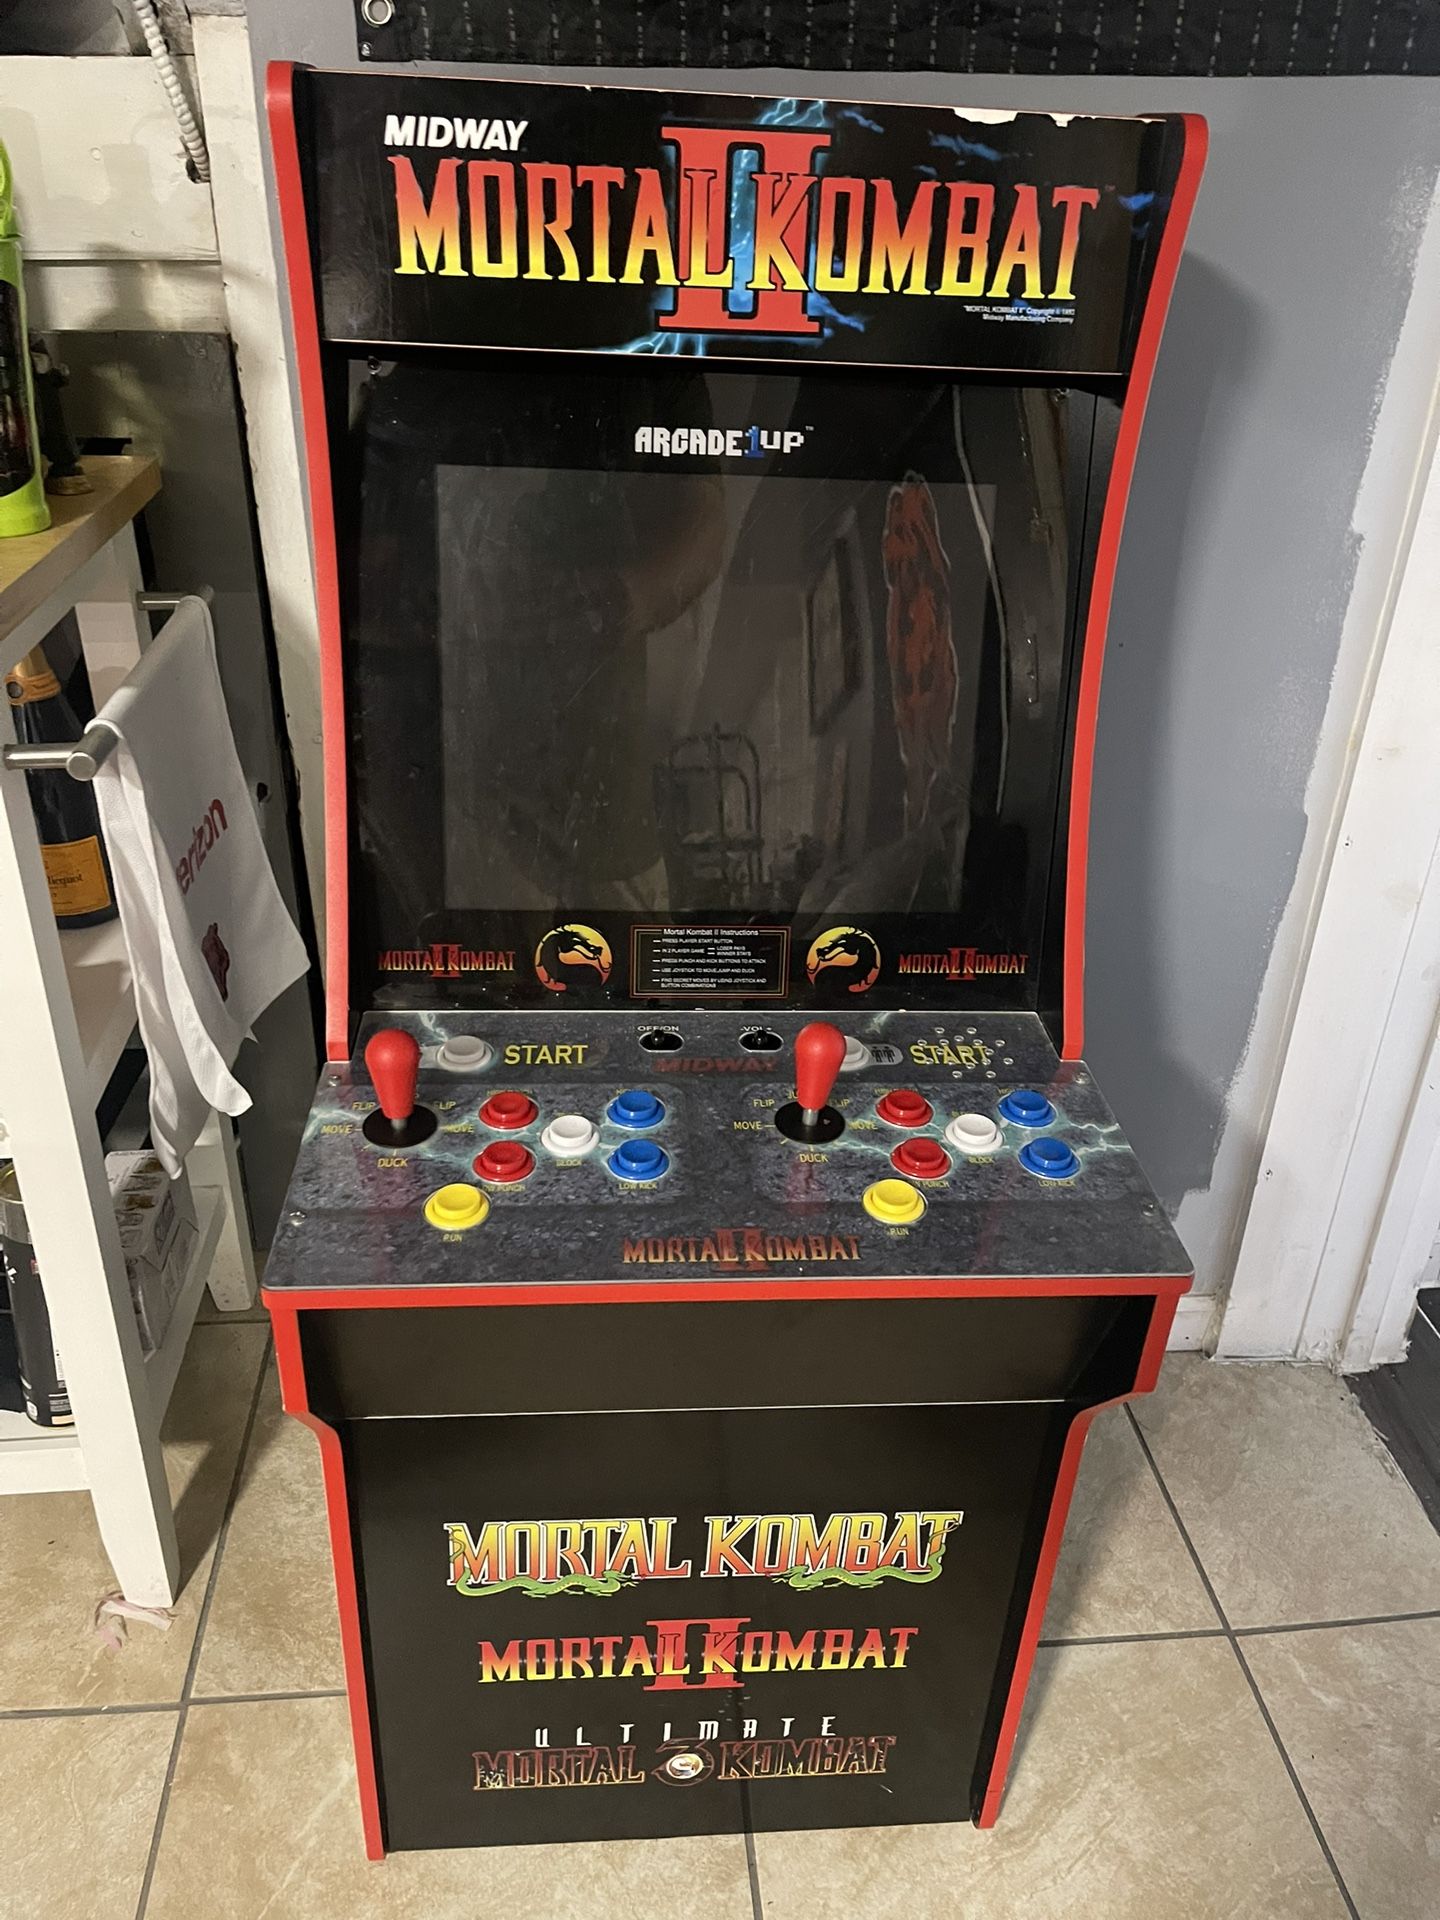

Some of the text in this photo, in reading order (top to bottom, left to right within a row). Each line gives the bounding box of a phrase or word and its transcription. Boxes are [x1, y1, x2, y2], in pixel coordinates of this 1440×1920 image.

[383, 115, 528, 151] MIDWAY
[388, 155, 1100, 299] MORTAL KOMBAT
[176, 798, 228, 896] erizon
[663, 928, 685, 936] Mortal
[686, 928, 713, 936] Kombat
[378, 950, 516, 971] MORTAL KOMBAT
[898, 953, 1029, 974] MORTAL KOMBAT
[504, 1044, 588, 1066] START
[909, 1044, 988, 1066] START
[653, 1056, 779, 1073] MIDWAY
[352, 1101, 376, 1111] FLIP
[753, 1100, 775, 1108] FLIP
[321, 1124, 353, 1135] MOVE
[446, 1123, 476, 1134] MOVE
[733, 1121, 763, 1130] MOVE
[848, 1121, 878, 1130] MOVE
[377, 1157, 409, 1168] DUCK
[556, 1159, 583, 1167] BLOCK
[799, 1153, 829, 1163] DUCK
[968, 1156, 995, 1164] BLOCK
[443, 1233, 463, 1243] RUN
[889, 1227, 910, 1236] RUN
[622, 1233, 862, 1264] MORTAL KOMBAT
[443, 1510, 964, 1588] MORTAL KOMBAT
[477, 1627, 920, 1684] MORTAL KOMBAT
[534, 1715, 836, 1749] ULTIMATE
[473, 1744, 646, 1791] MORTAL
[717, 1735, 898, 1781] KOMBAT
